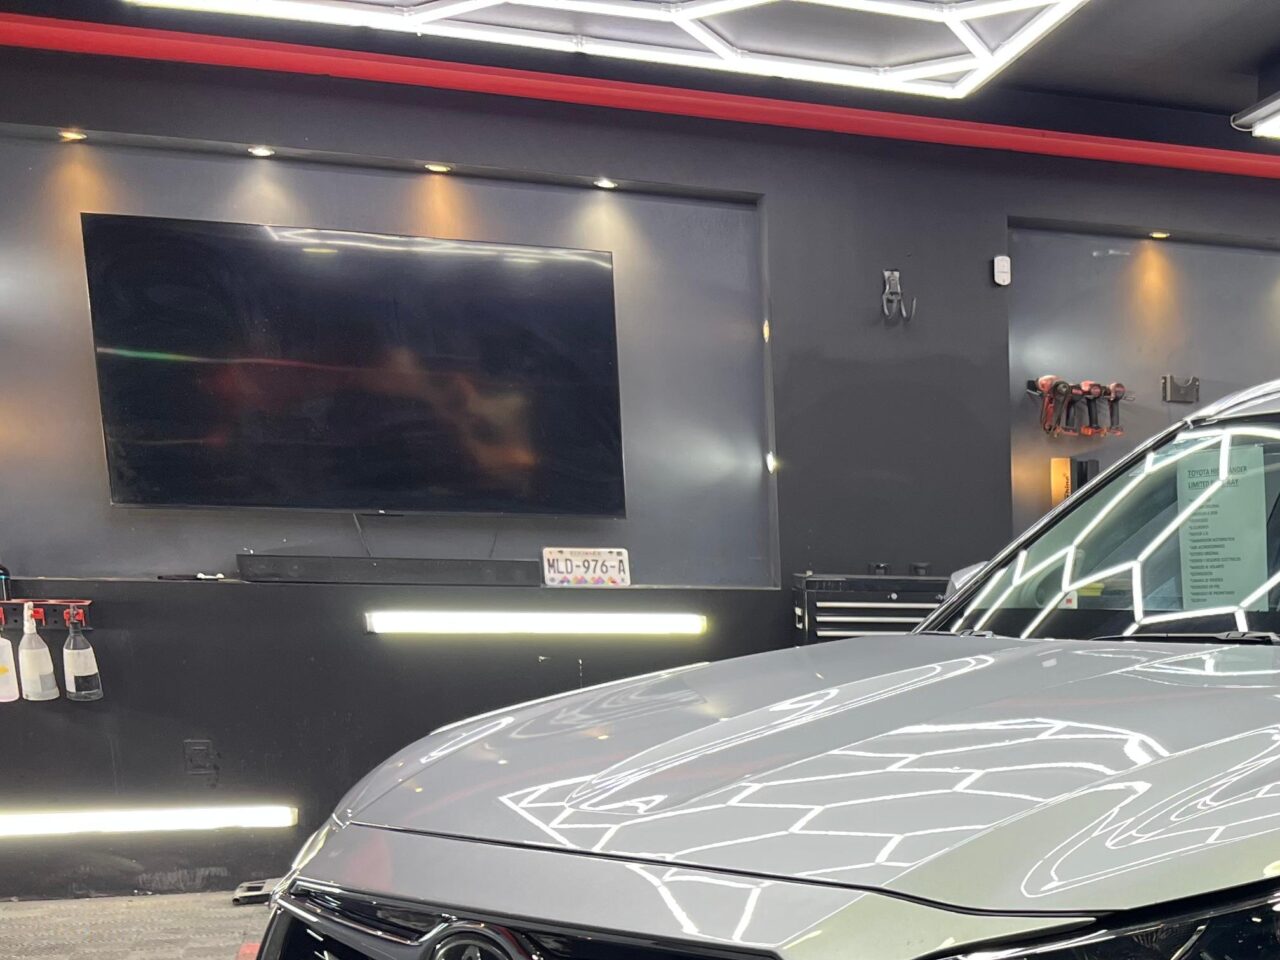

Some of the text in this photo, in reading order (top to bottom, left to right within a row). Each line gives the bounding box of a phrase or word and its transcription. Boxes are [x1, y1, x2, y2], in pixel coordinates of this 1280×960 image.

[1187, 465, 1248, 478] TOYOTA HIANDER
[547, 558, 626, 575] MLD-976-A
